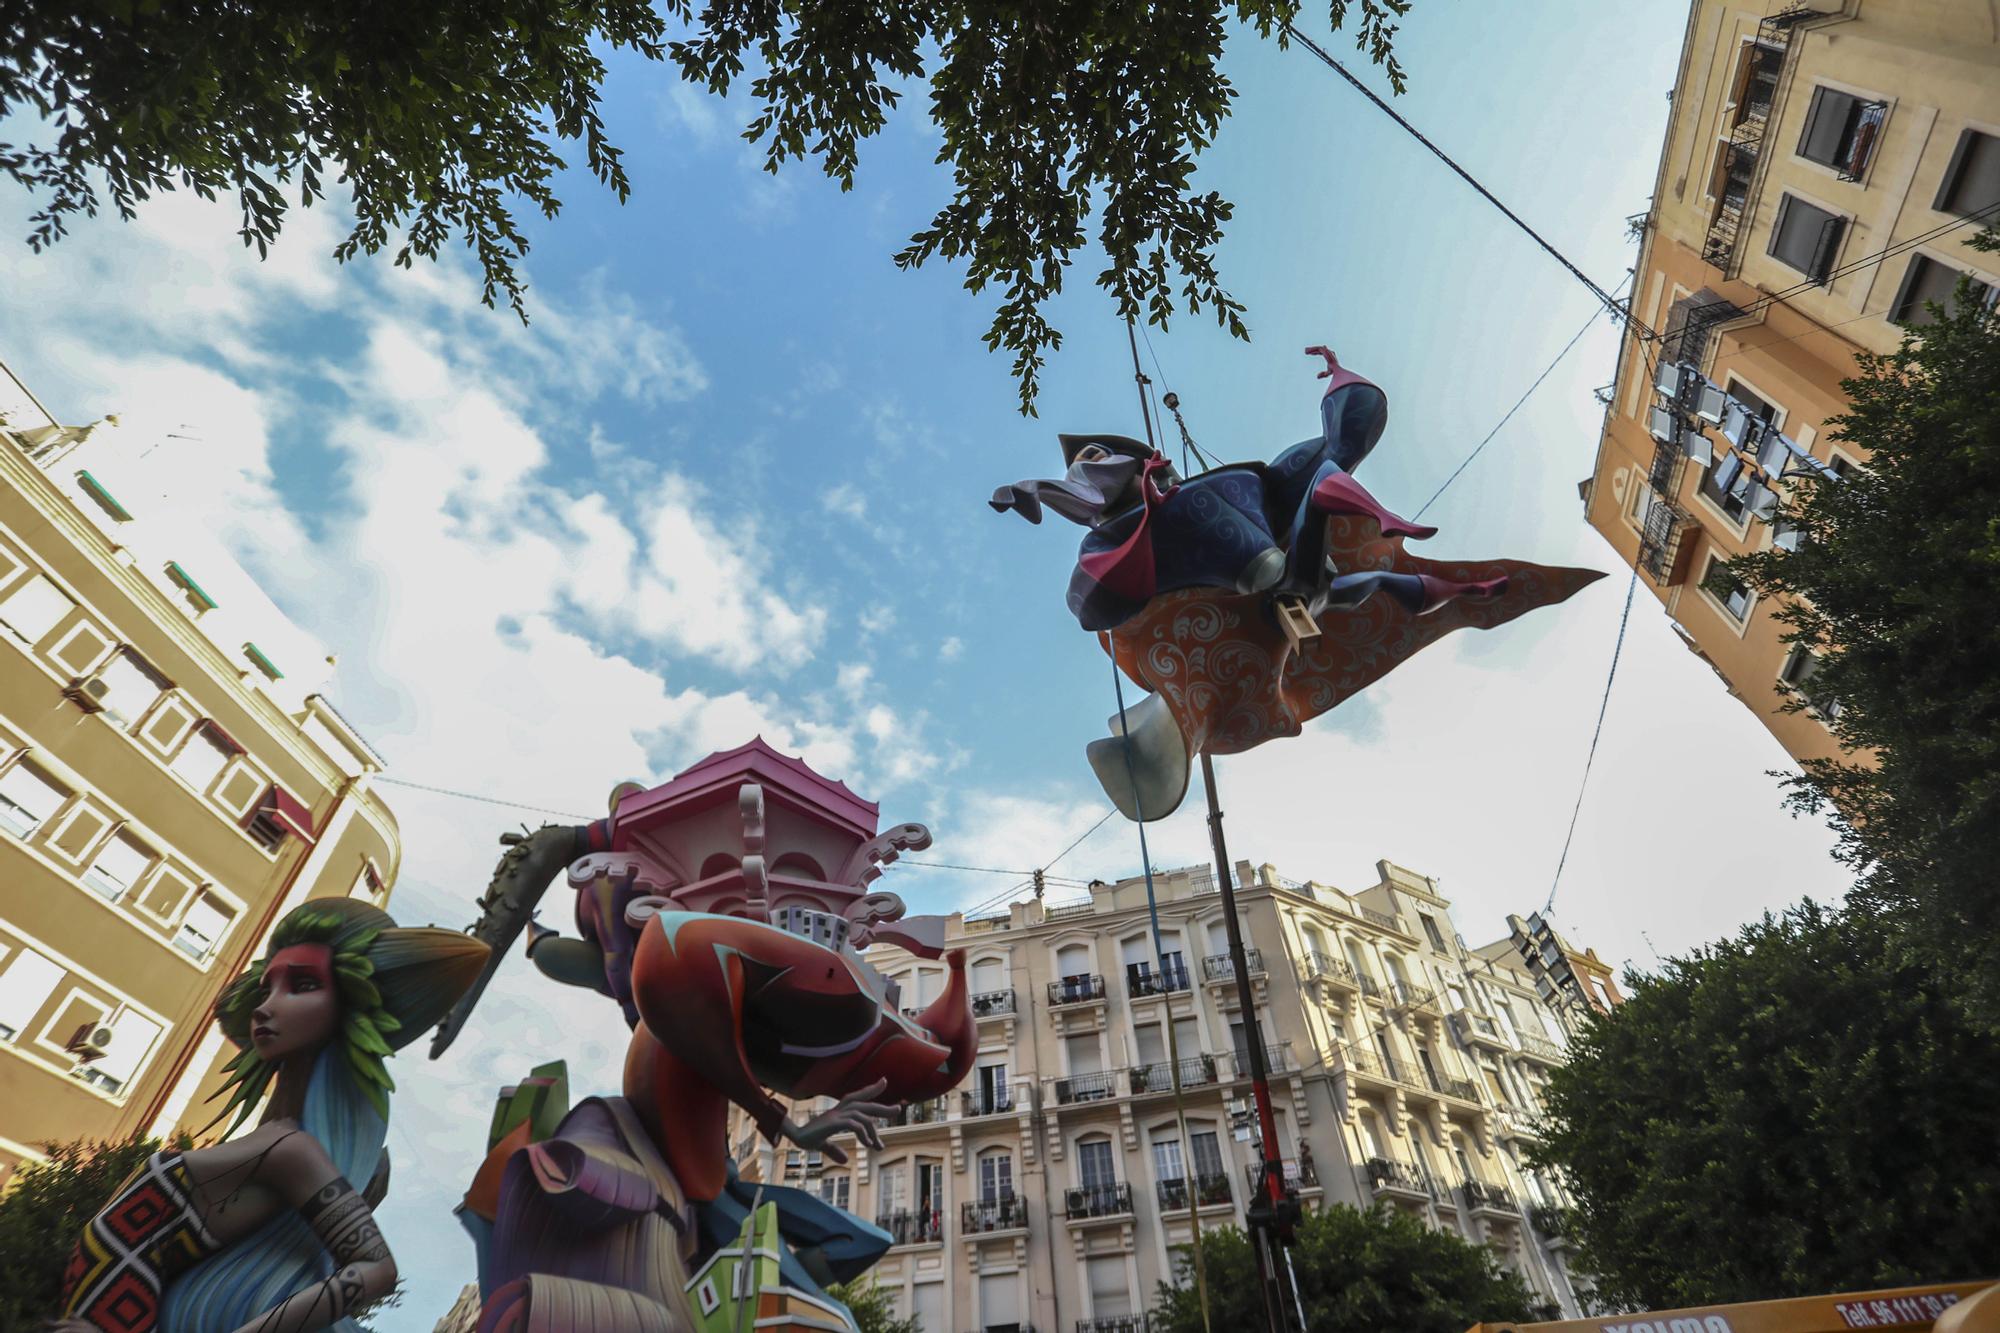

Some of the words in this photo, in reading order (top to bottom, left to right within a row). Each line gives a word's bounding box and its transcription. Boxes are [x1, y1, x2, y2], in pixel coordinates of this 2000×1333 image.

[1835, 1302, 1877, 1328] Telf.
[1870, 1300, 1898, 1325] 96
[1892, 1297, 1927, 1321] 111
